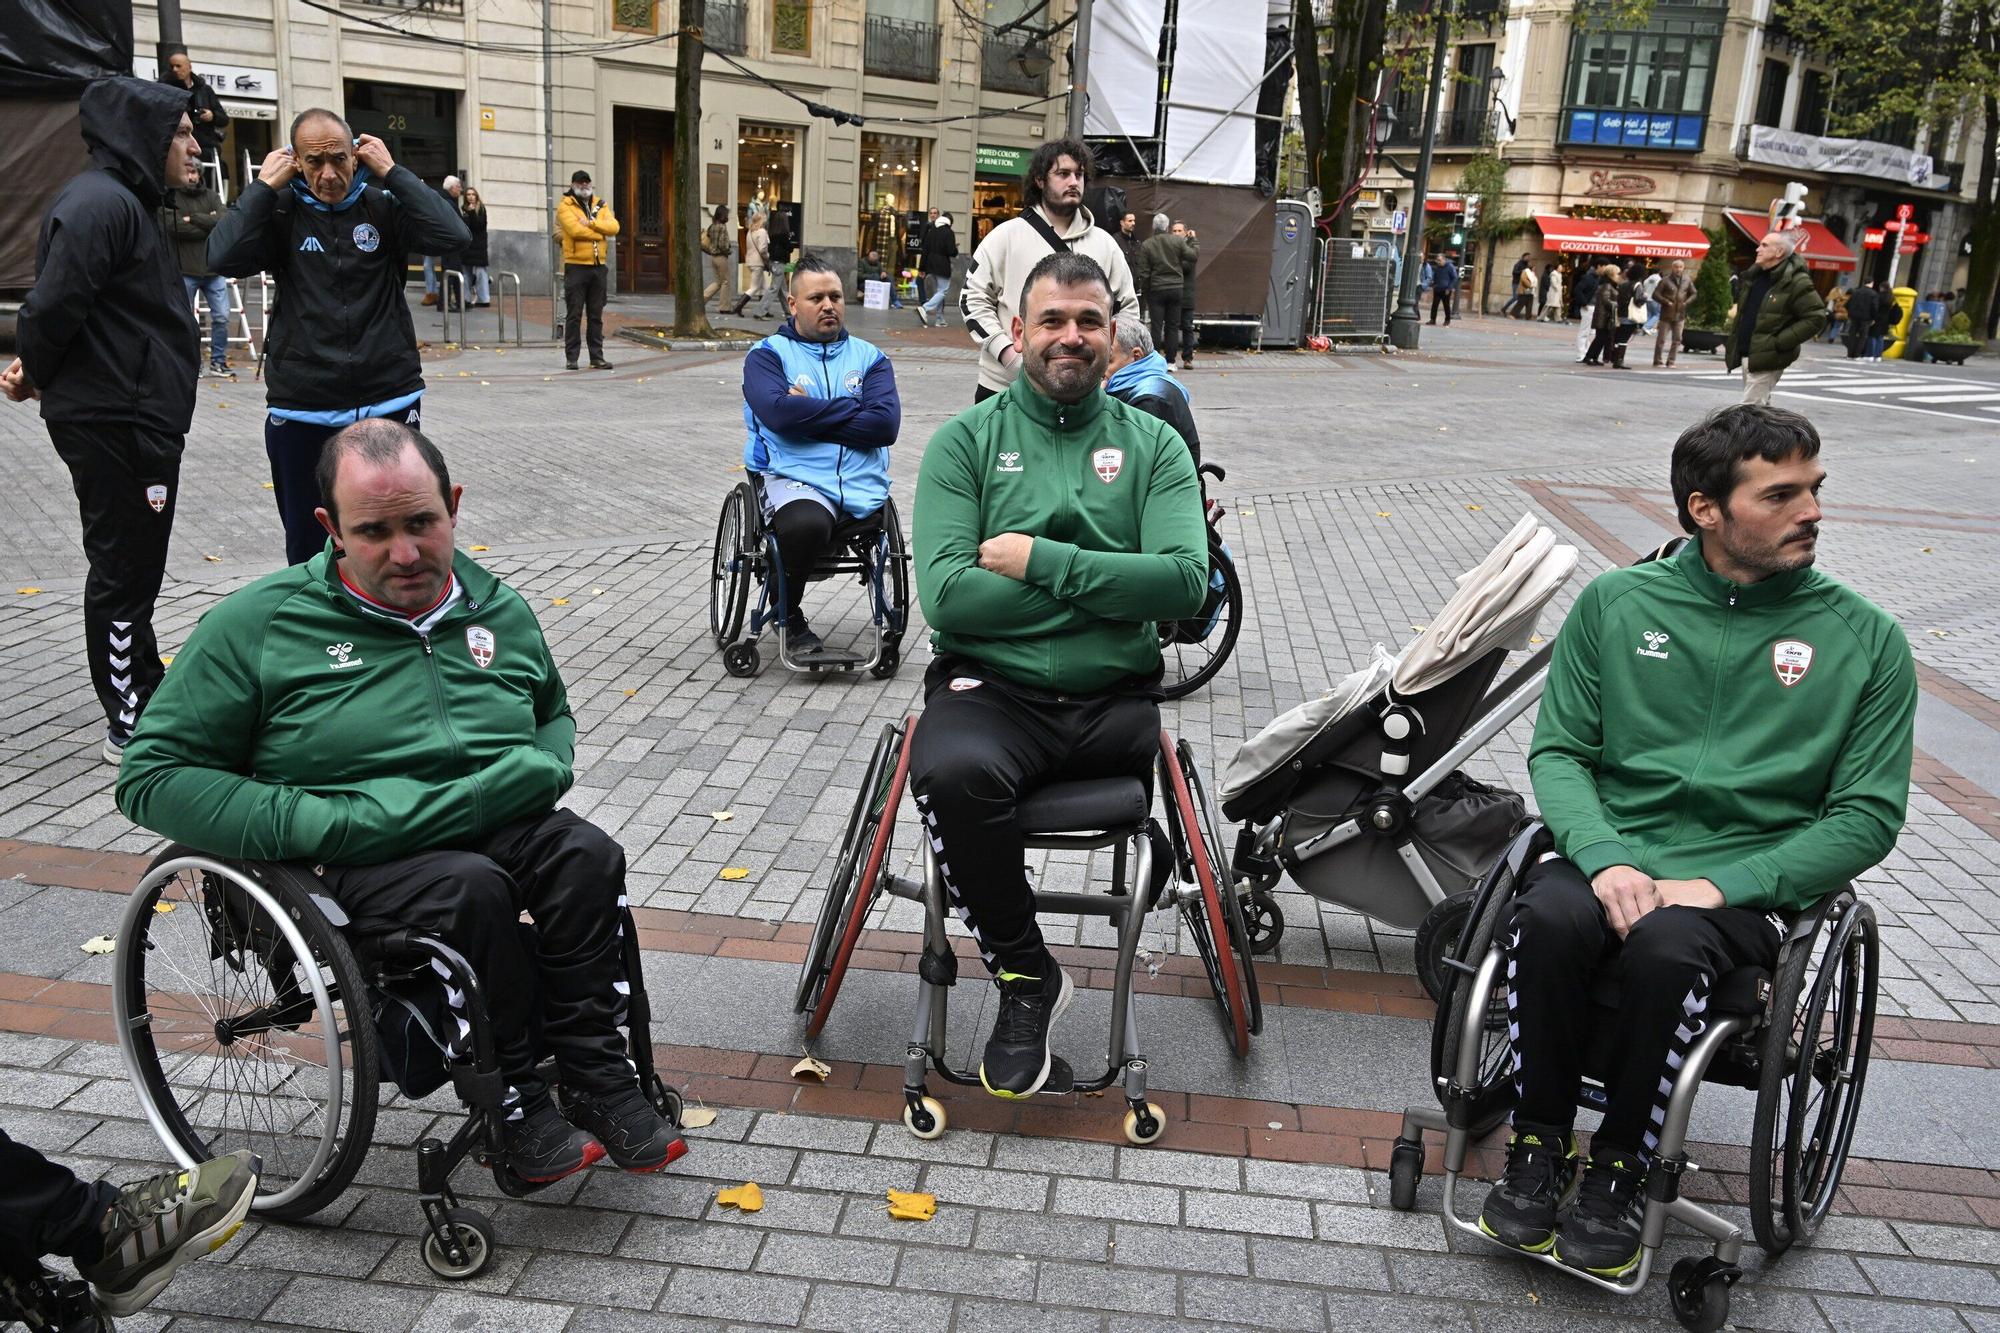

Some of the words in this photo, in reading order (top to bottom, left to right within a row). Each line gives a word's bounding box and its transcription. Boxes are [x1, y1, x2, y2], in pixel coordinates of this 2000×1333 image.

[152, 68, 226, 86] LSTE
[388, 114, 407, 130] 28
[976, 148, 997, 157] UNITED
[997, 150, 1020, 159] COLORS
[1560, 241, 1620, 253] GOZOTEGIA
[1634, 246, 1692, 258] PASTELERIA
[996, 464, 1024, 472] hummel
[1636, 646, 1669, 660] hummel
[329, 657, 364, 670] hummel
